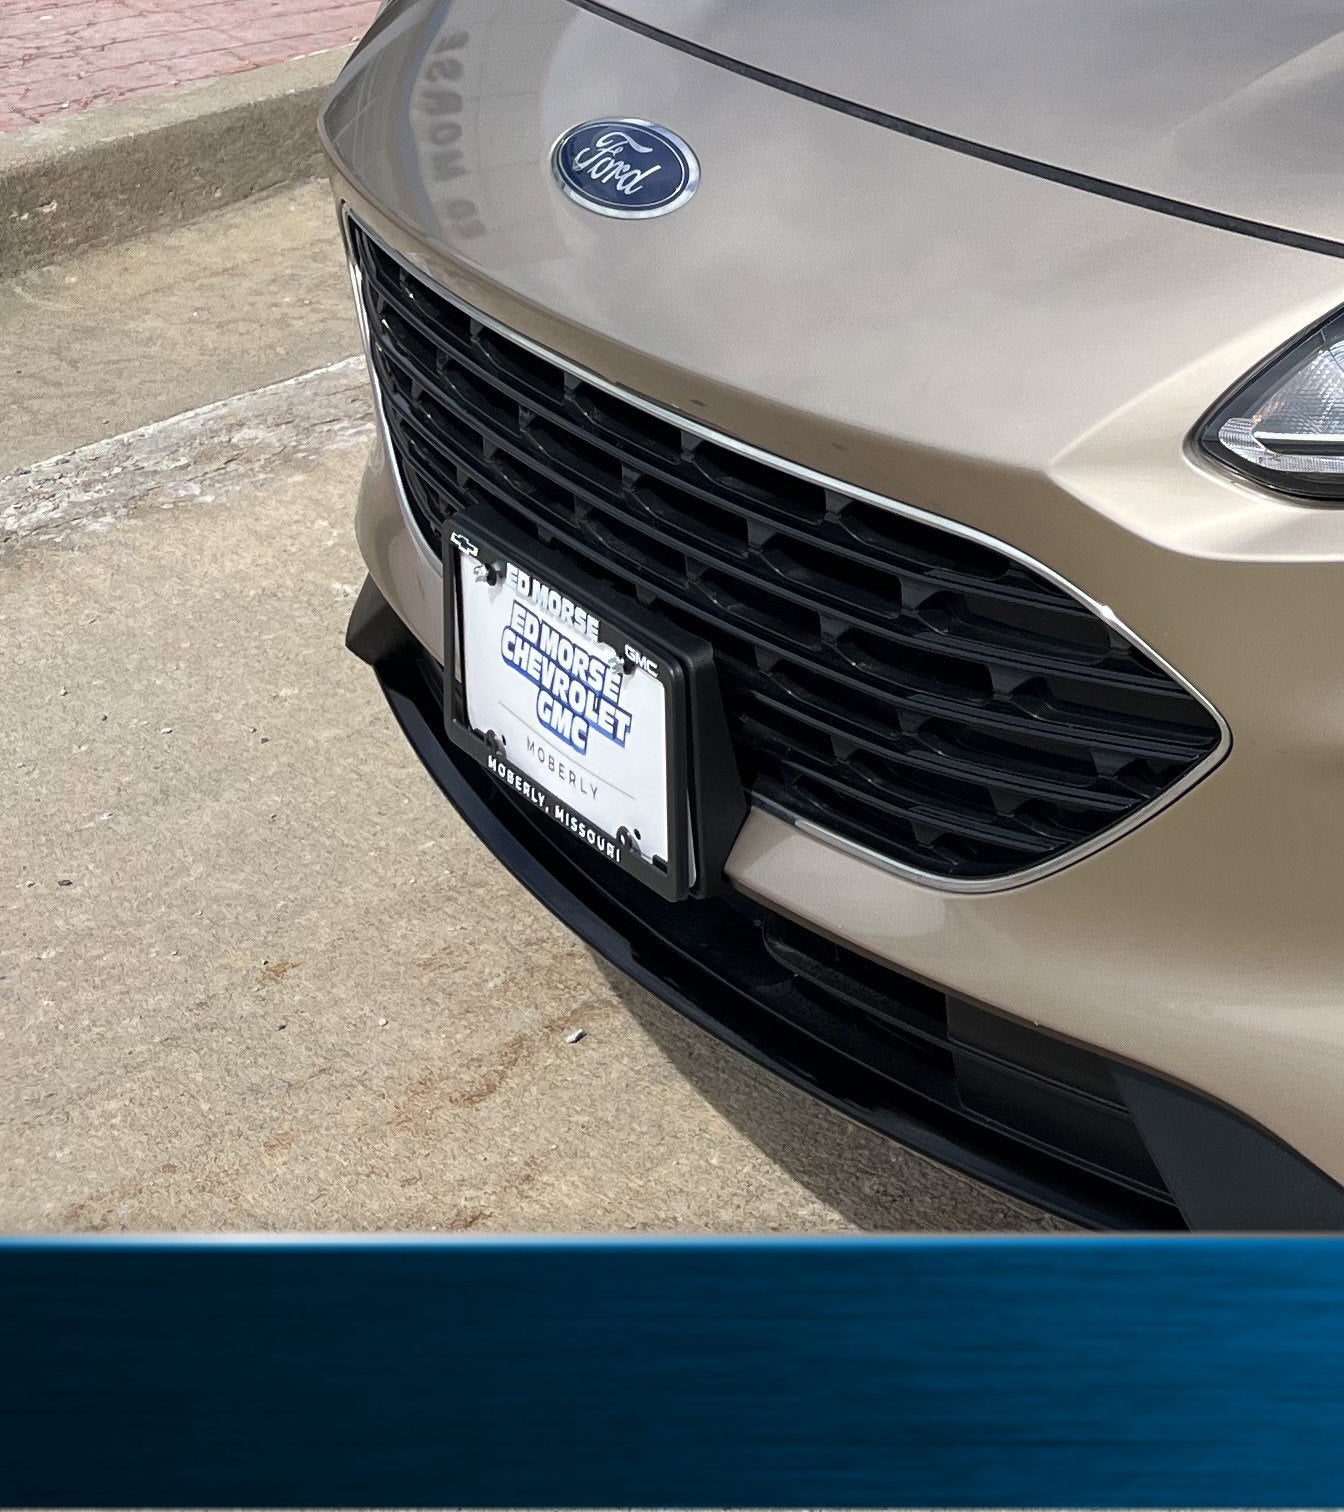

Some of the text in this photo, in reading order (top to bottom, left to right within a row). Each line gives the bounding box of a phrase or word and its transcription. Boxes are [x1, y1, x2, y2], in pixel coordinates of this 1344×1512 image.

[573, 131, 662, 195] Ford
[506, 562, 600, 643] ED MORSE
[501, 626, 633, 748] CHEVROLET
[510, 599, 624, 702] ED MORSE
[624, 644, 659, 678] GMC
[537, 688, 590, 755] GMC
[526, 736, 599, 801] MOBERLY
[488, 754, 621, 863] MOBERLY, MISSOURI
